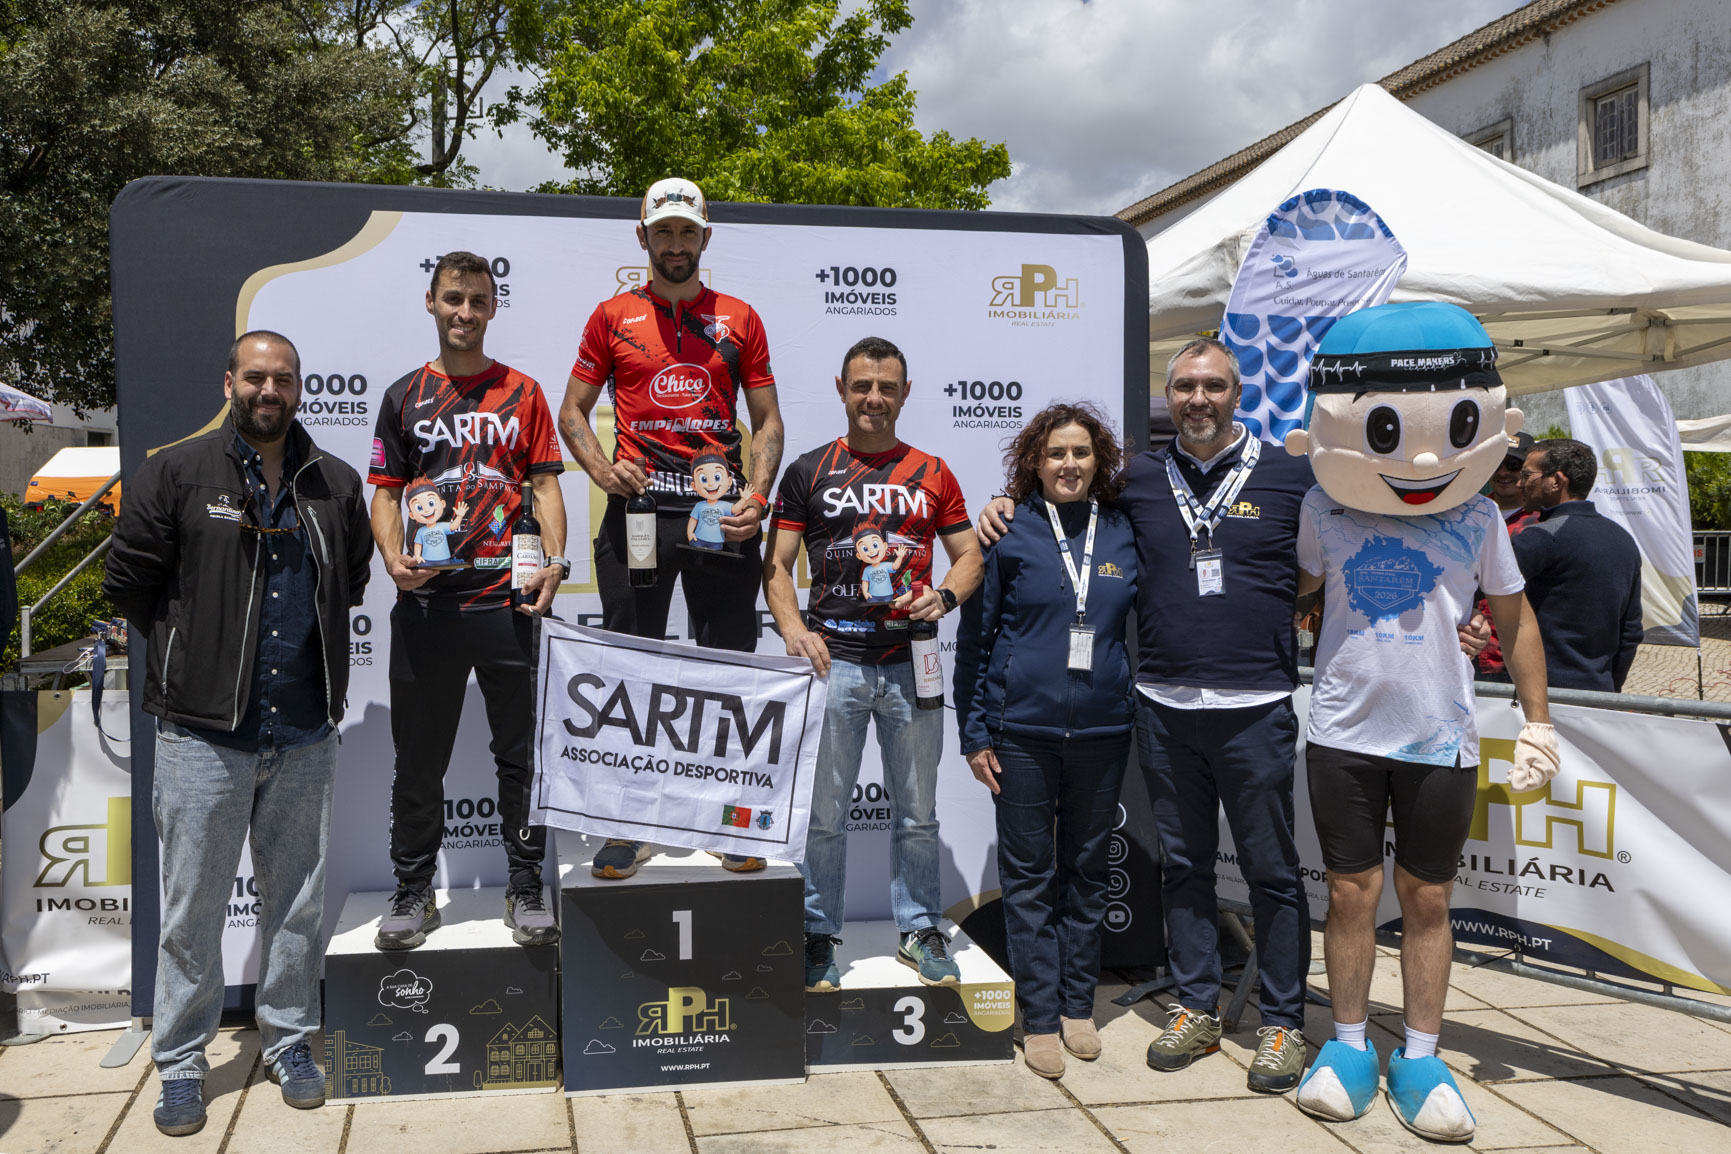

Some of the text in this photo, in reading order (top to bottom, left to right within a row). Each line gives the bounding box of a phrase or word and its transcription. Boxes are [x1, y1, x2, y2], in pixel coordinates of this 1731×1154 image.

[815, 266, 897, 287] +1000
[1307, 267, 1332, 280] Águas
[1334, 268, 1345, 278] de
[825, 290, 897, 305] IMÓVEIS
[825, 307, 897, 316] ANGARIADOS
[988, 310, 1080, 320] IMOBILIÁRIA
[1391, 356, 1454, 367] PACE MAKERS
[304, 373, 367, 395] 000
[654, 374, 705, 394] Chico
[944, 380, 1023, 401] +1000
[298, 398, 368, 414] MÓVEIS
[953, 403, 1023, 418] IMÓVEIS
[301, 417, 368, 426] GARIADOS
[953, 420, 1023, 429] ANGARIADOS
[561, 745, 774, 789] ASSOCIAÇÃO DESPORTIVA
[1478, 880, 1547, 898] ESTATE
[88, 916, 124, 925] REAL
[672, 910, 692, 960] 1
[395, 980, 425, 997] sonho
[974, 990, 1011, 1000] +1000
[38, 1005, 79, 1016] MEDIAÇÃO
[974, 1001, 1011, 1010] IMÓVEIS
[892, 996, 925, 1045] 3
[632, 1034, 730, 1048] IMOBILIÁRIA
[424, 1023, 460, 1075] 2
[661, 1062, 711, 1072] WWW.RPH.PT
